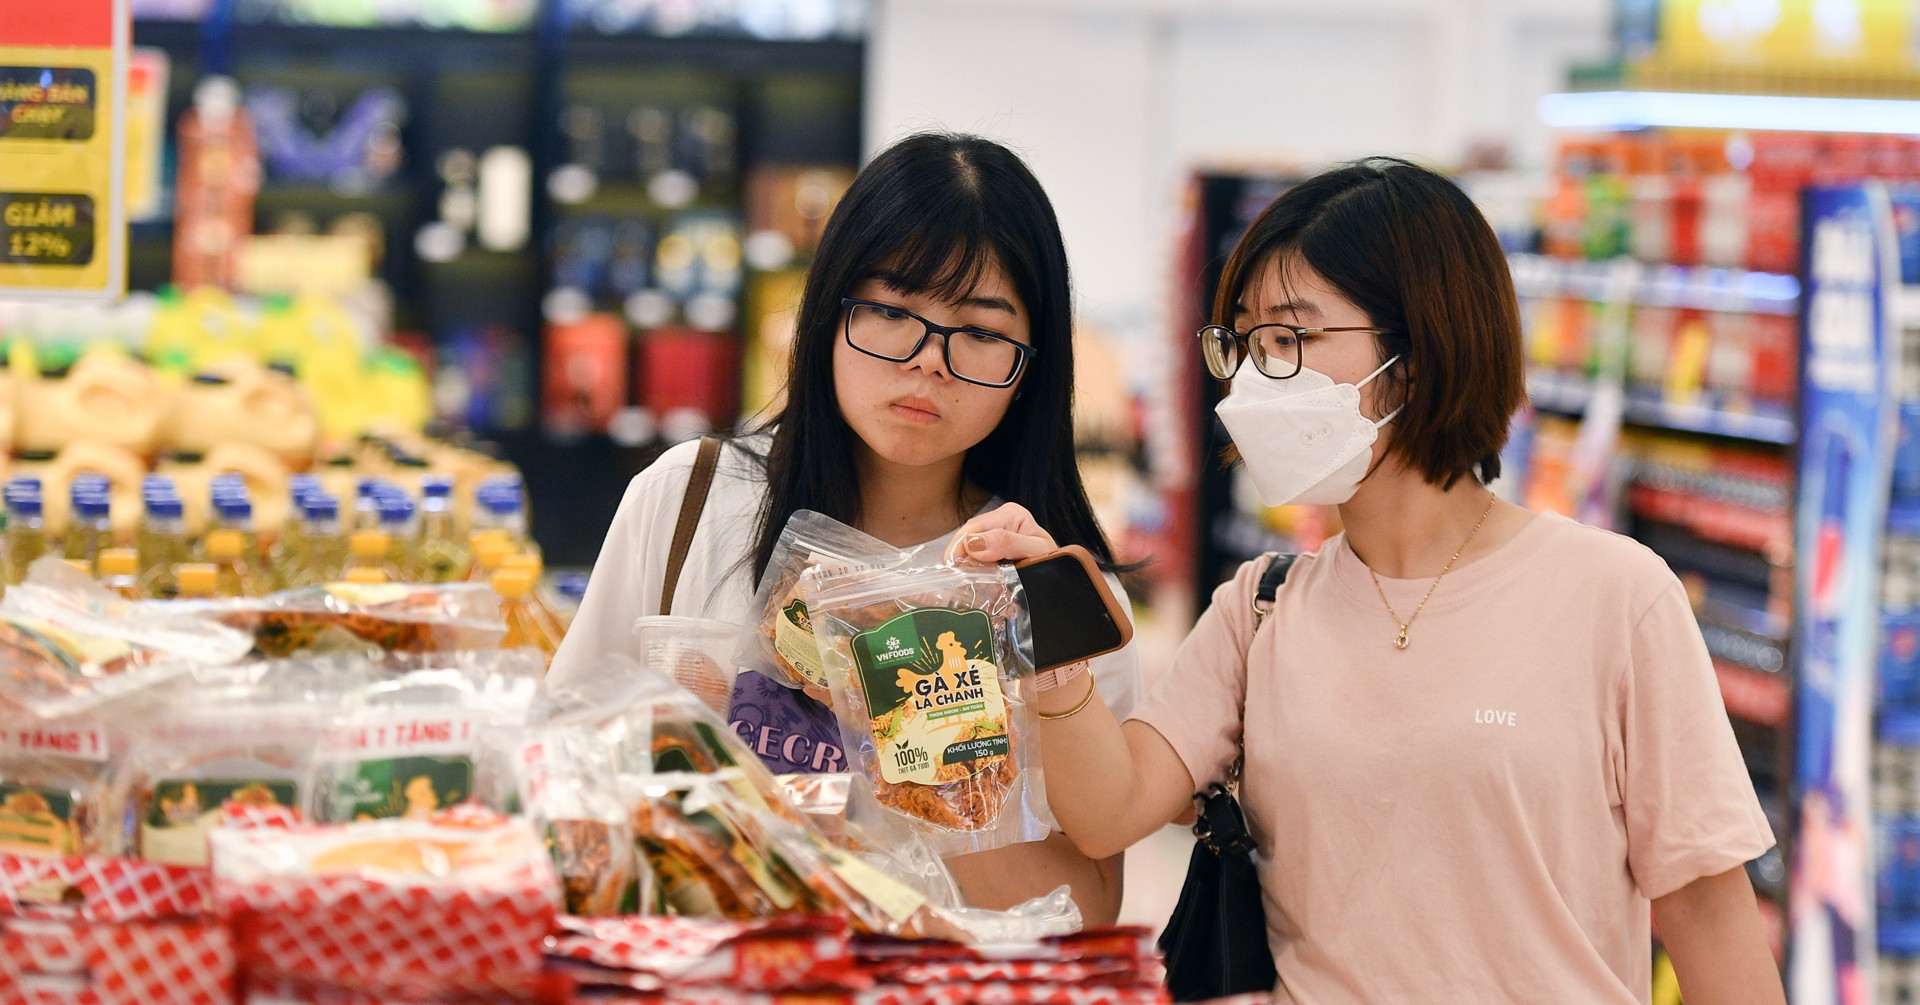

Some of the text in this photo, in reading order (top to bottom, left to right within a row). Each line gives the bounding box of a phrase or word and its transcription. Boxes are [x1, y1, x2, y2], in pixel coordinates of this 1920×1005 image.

[4, 197, 76, 228] GIẢM
[9, 231, 71, 257] 12%
[876, 647, 915, 662] VNFOODS
[915, 664, 981, 696] GÀ XÉ
[936, 687, 984, 706] CHANH
[1475, 709, 1517, 727] LOVE
[462, 721, 470, 740] 1
[89, 730, 99, 754] 1
[730, 720, 849, 774] CECR
[946, 743, 967, 755] KHỐI
[967, 739, 992, 751] LƯỢNG
[894, 746, 928, 767] 100%
[974, 749, 988, 758] 150
